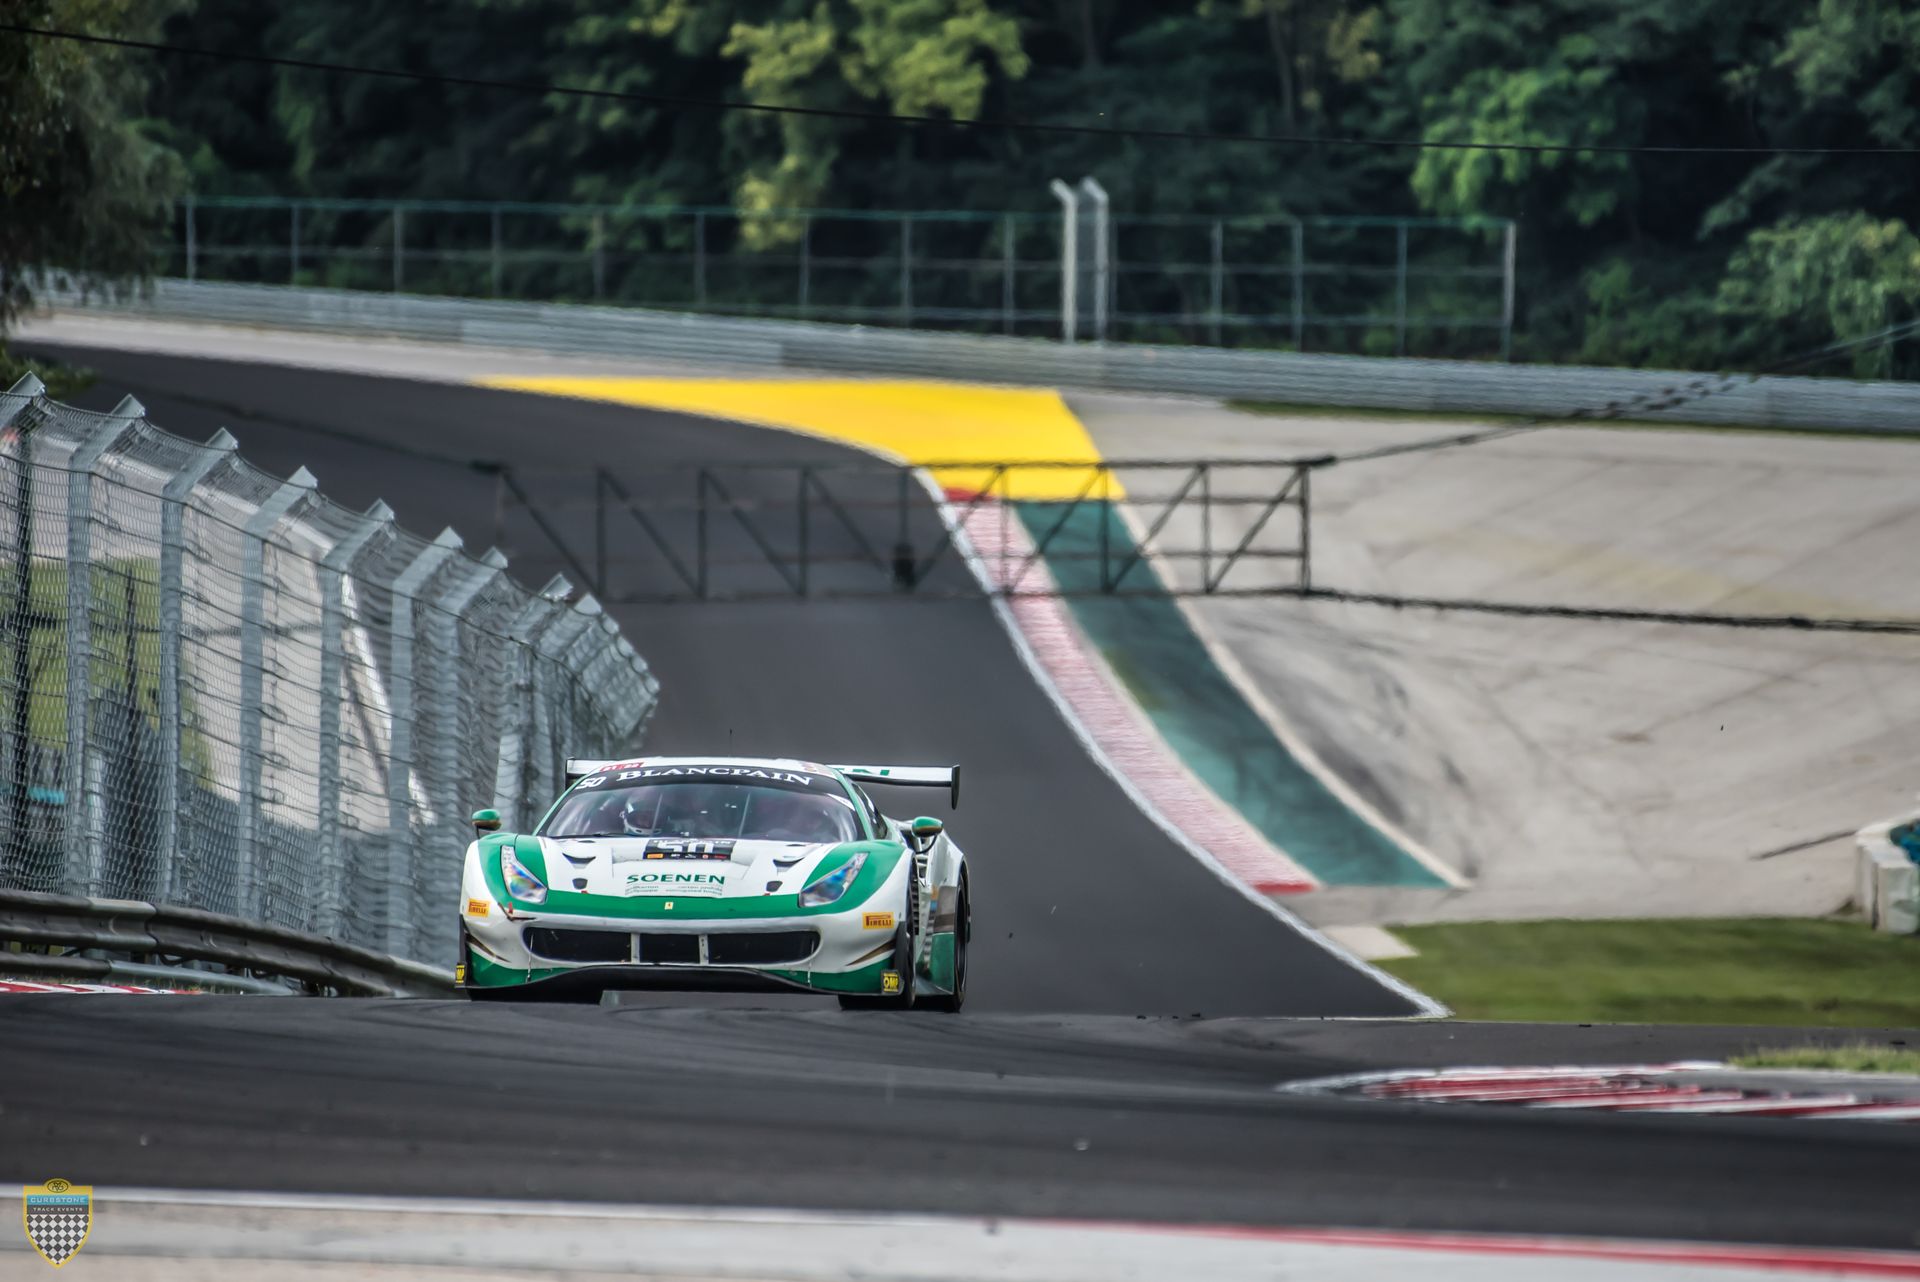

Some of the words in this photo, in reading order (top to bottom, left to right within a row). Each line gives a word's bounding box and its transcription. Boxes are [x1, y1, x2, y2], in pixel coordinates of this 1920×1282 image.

[574, 776, 607, 790] 50
[616, 767, 814, 786] BLANCPAIN
[626, 874, 726, 885] SOENEN
[865, 914, 892, 926] PIRELLI
[883, 976, 899, 989] OMP
